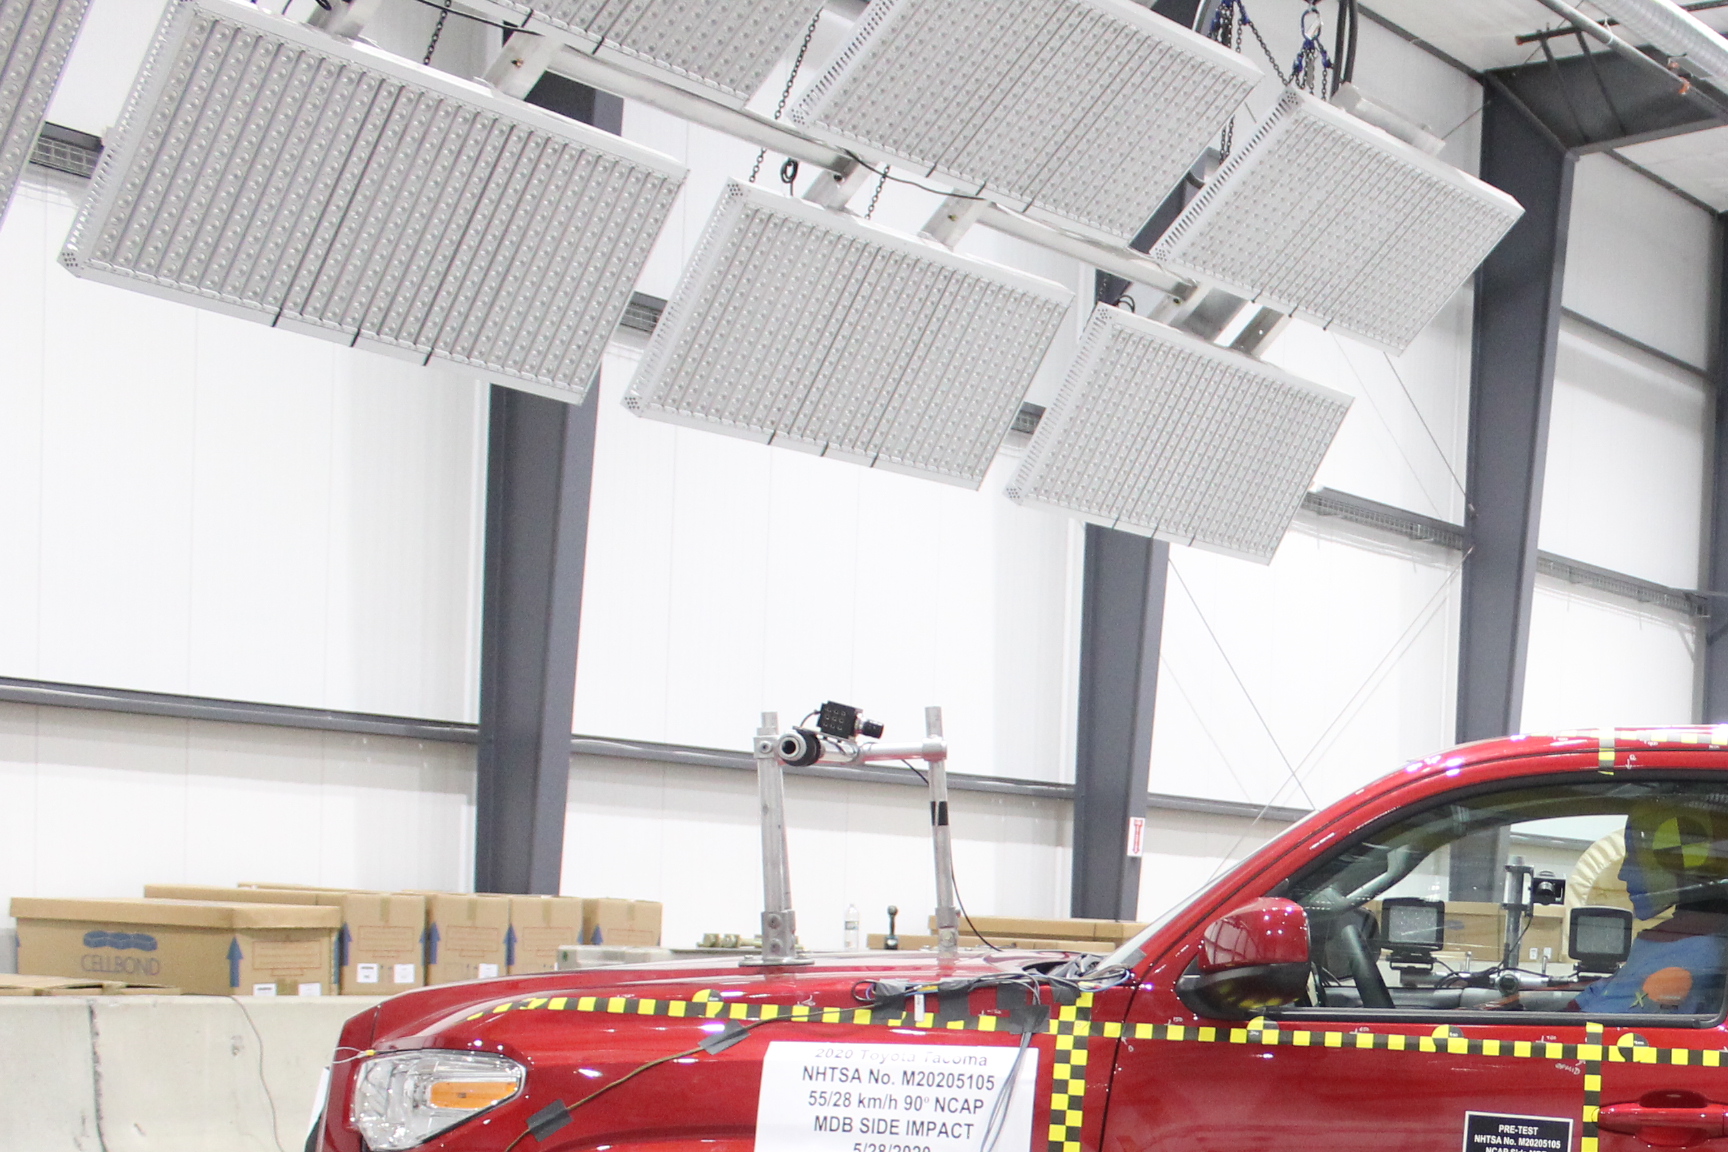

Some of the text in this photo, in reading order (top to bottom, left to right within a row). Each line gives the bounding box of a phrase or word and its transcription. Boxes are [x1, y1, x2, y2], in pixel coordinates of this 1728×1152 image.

[82, 954, 160, 976] CELLBOND
[814, 1047, 854, 1060] 2020
[802, 1066, 996, 1091] NHTSA No. M20205105
[808, 1091, 852, 1108] 55/28
[857, 1092, 898, 1110] km/h
[934, 1096, 985, 1115] NCAP
[813, 1115, 975, 1140] MDB SIDE IMPACT
[1498, 1124, 1539, 1135] PRE-TEST
[1474, 1134, 1561, 1149] NHTSA No. M20205105
